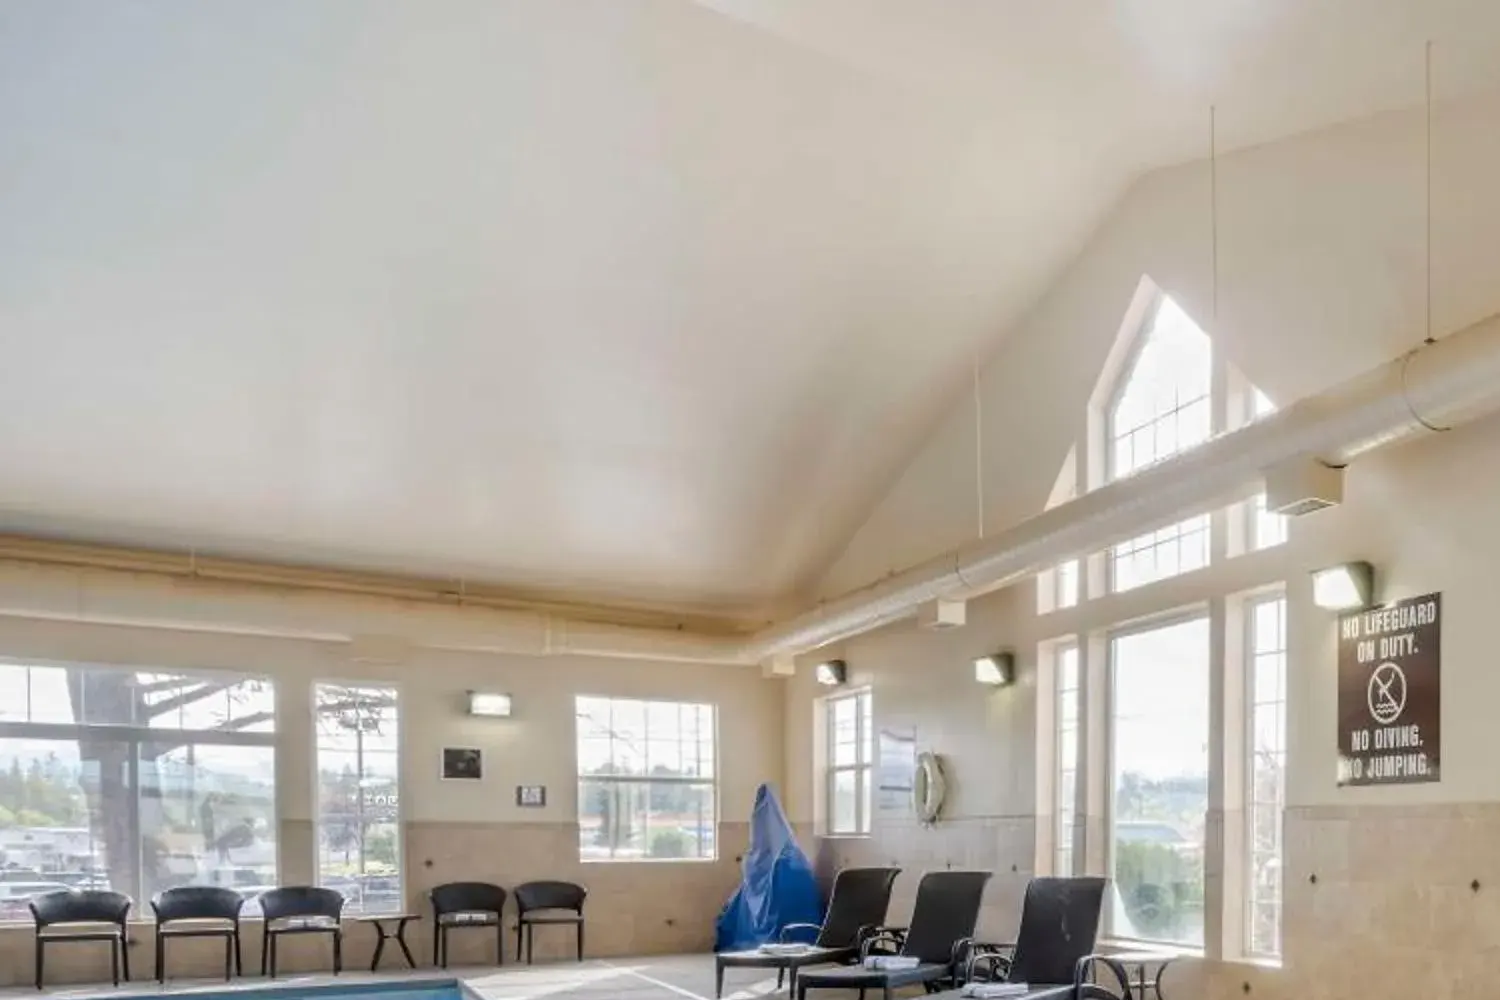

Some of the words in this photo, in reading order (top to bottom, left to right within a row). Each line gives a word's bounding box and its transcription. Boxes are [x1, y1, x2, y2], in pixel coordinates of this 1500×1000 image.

[1343, 616, 1359, 639] NO
[1365, 601, 1436, 634] LIFEGUARD
[1357, 641, 1375, 663] ON
[1380, 634, 1419, 660] DUTY.
[1352, 729, 1369, 752] NO
[1346, 758, 1363, 779] NO
[1367, 753, 1432, 779] JUMPING.
